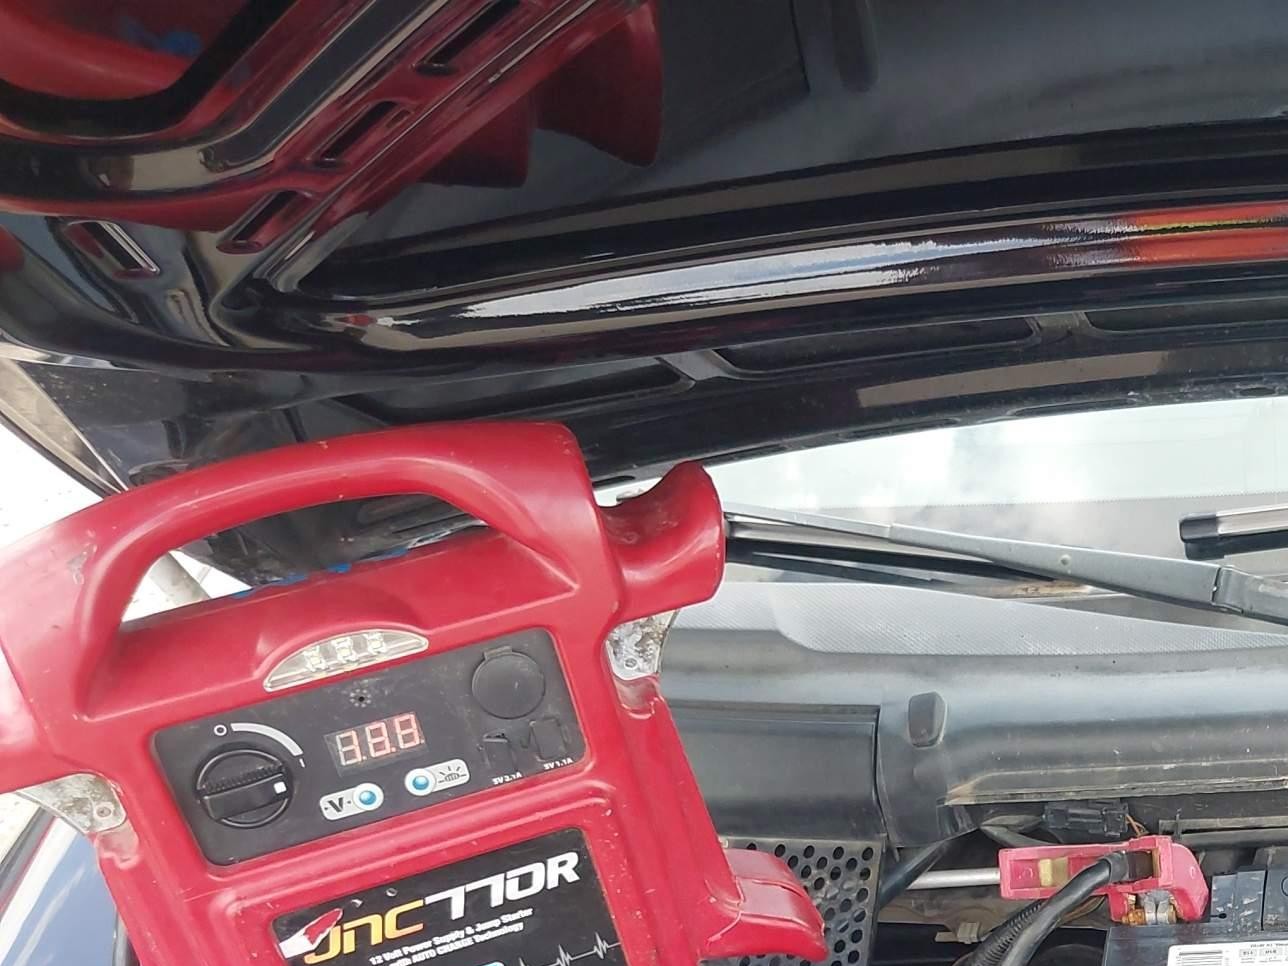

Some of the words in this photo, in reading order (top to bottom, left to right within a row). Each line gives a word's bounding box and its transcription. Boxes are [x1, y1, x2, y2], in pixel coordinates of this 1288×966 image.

[383, 949, 403, 962] Volt
[403, 940, 433, 956] Power
[432, 929, 466, 947] Supply
[465, 926, 475, 935] &
[475, 918, 501, 933] Jump
[412, 949, 438, 963] AUTO
[473, 922, 525, 944] Technology
